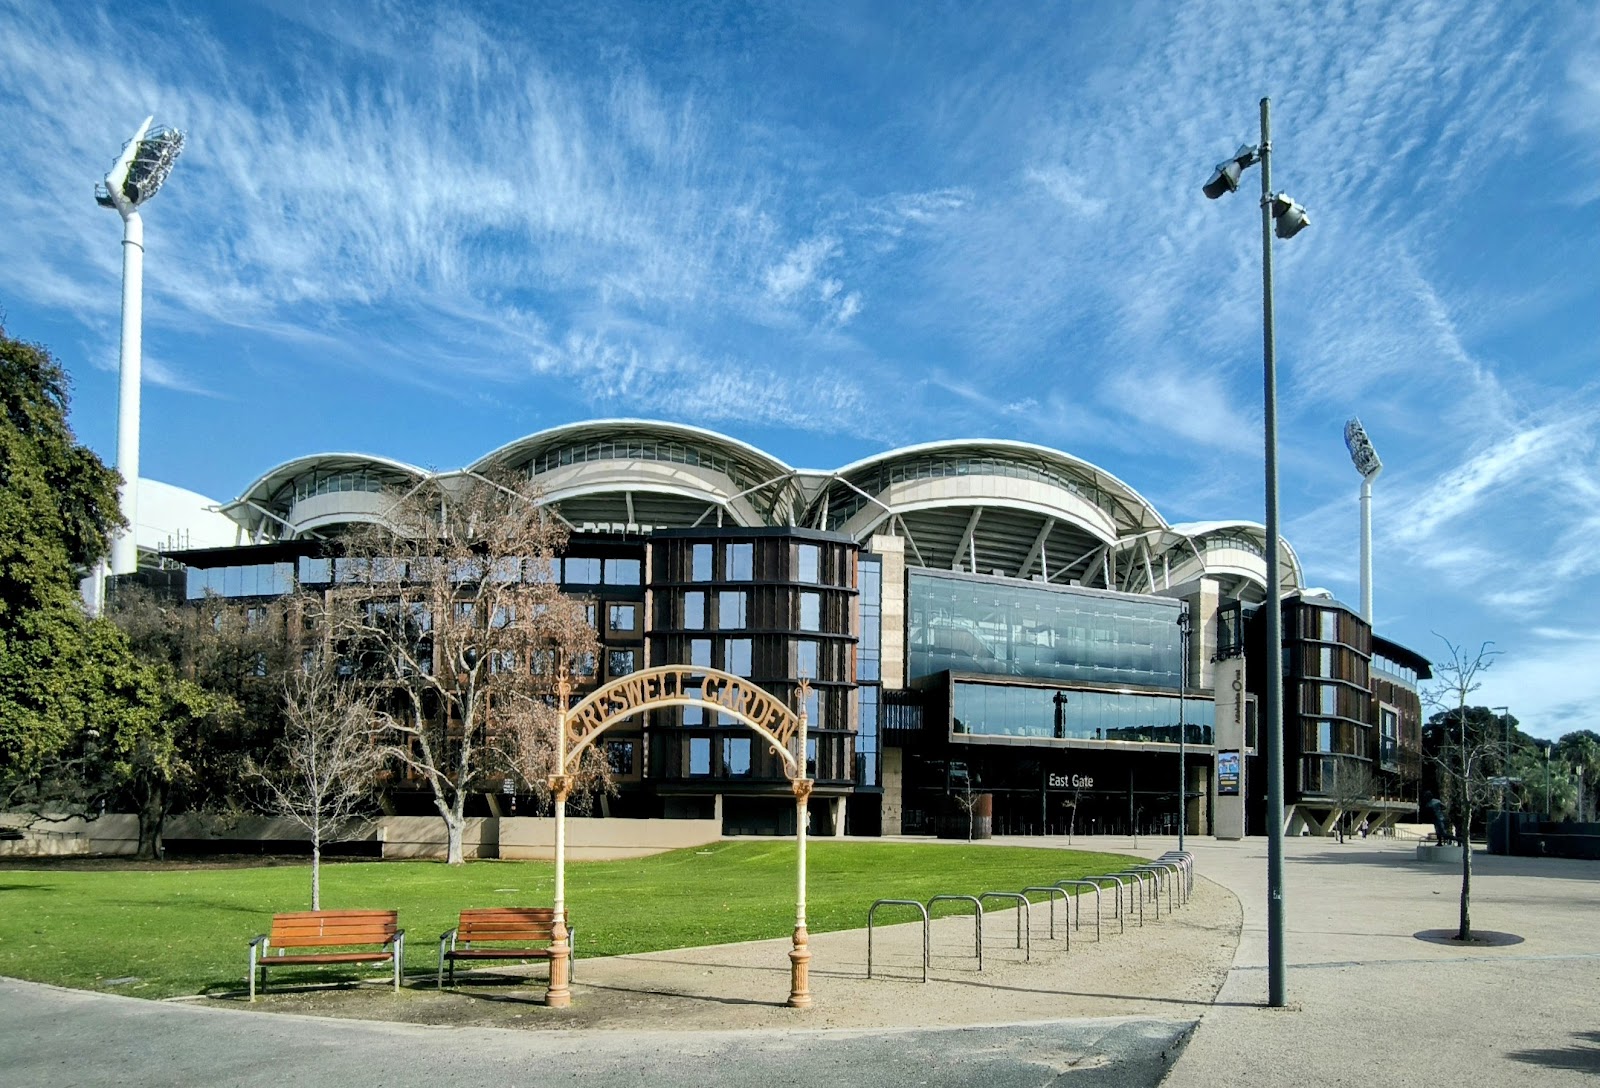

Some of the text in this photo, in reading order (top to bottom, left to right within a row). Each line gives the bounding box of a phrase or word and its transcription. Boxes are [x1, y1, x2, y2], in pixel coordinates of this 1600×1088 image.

[566, 671, 799, 747] CRESWELL GARDEN
[1049, 773, 1094, 787] East Gate
